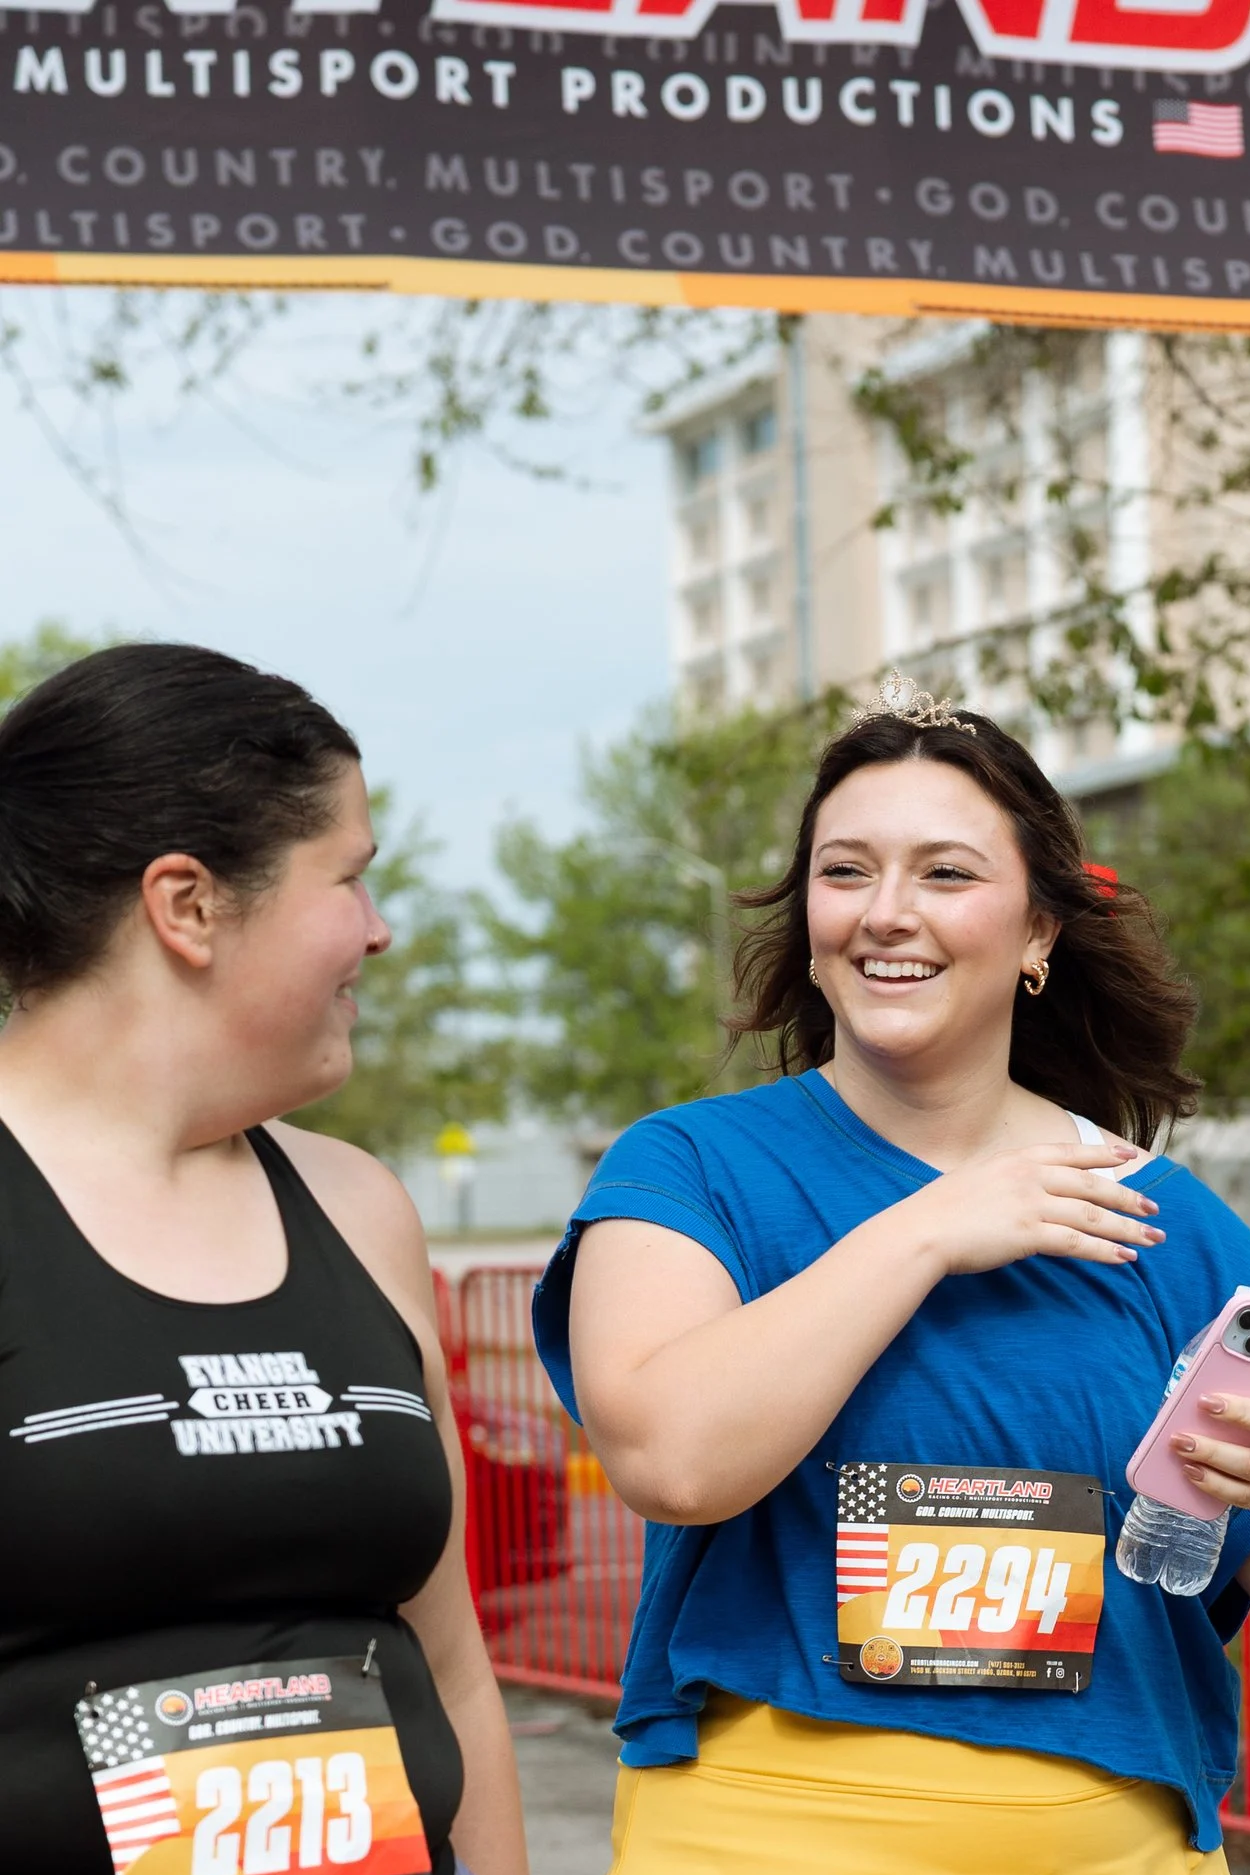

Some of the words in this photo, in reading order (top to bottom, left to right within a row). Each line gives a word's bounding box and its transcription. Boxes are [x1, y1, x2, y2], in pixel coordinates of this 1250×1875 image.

[14, 46, 516, 108] MULTISPORT
[561, 67, 1125, 147] PRODUCTIONS
[57, 145, 397, 189] COUNTRY.
[425, 152, 853, 211] MULTISPORT
[618, 229, 946, 276] COUNTRY.
[178, 1351, 321, 1388] EVANGEL
[213, 1391, 312, 1411] CHEER
[170, 1411, 365, 1456] UNIVERSITY
[928, 1477, 1053, 1499] HEARTLAND
[916, 1506, 936, 1517] GOD.
[938, 1506, 979, 1519] COUNTRY.
[981, 1508, 1035, 1521] MULTISPORT.
[882, 1542, 1071, 1634] 2294
[194, 1673, 332, 1710] HEARTLAND
